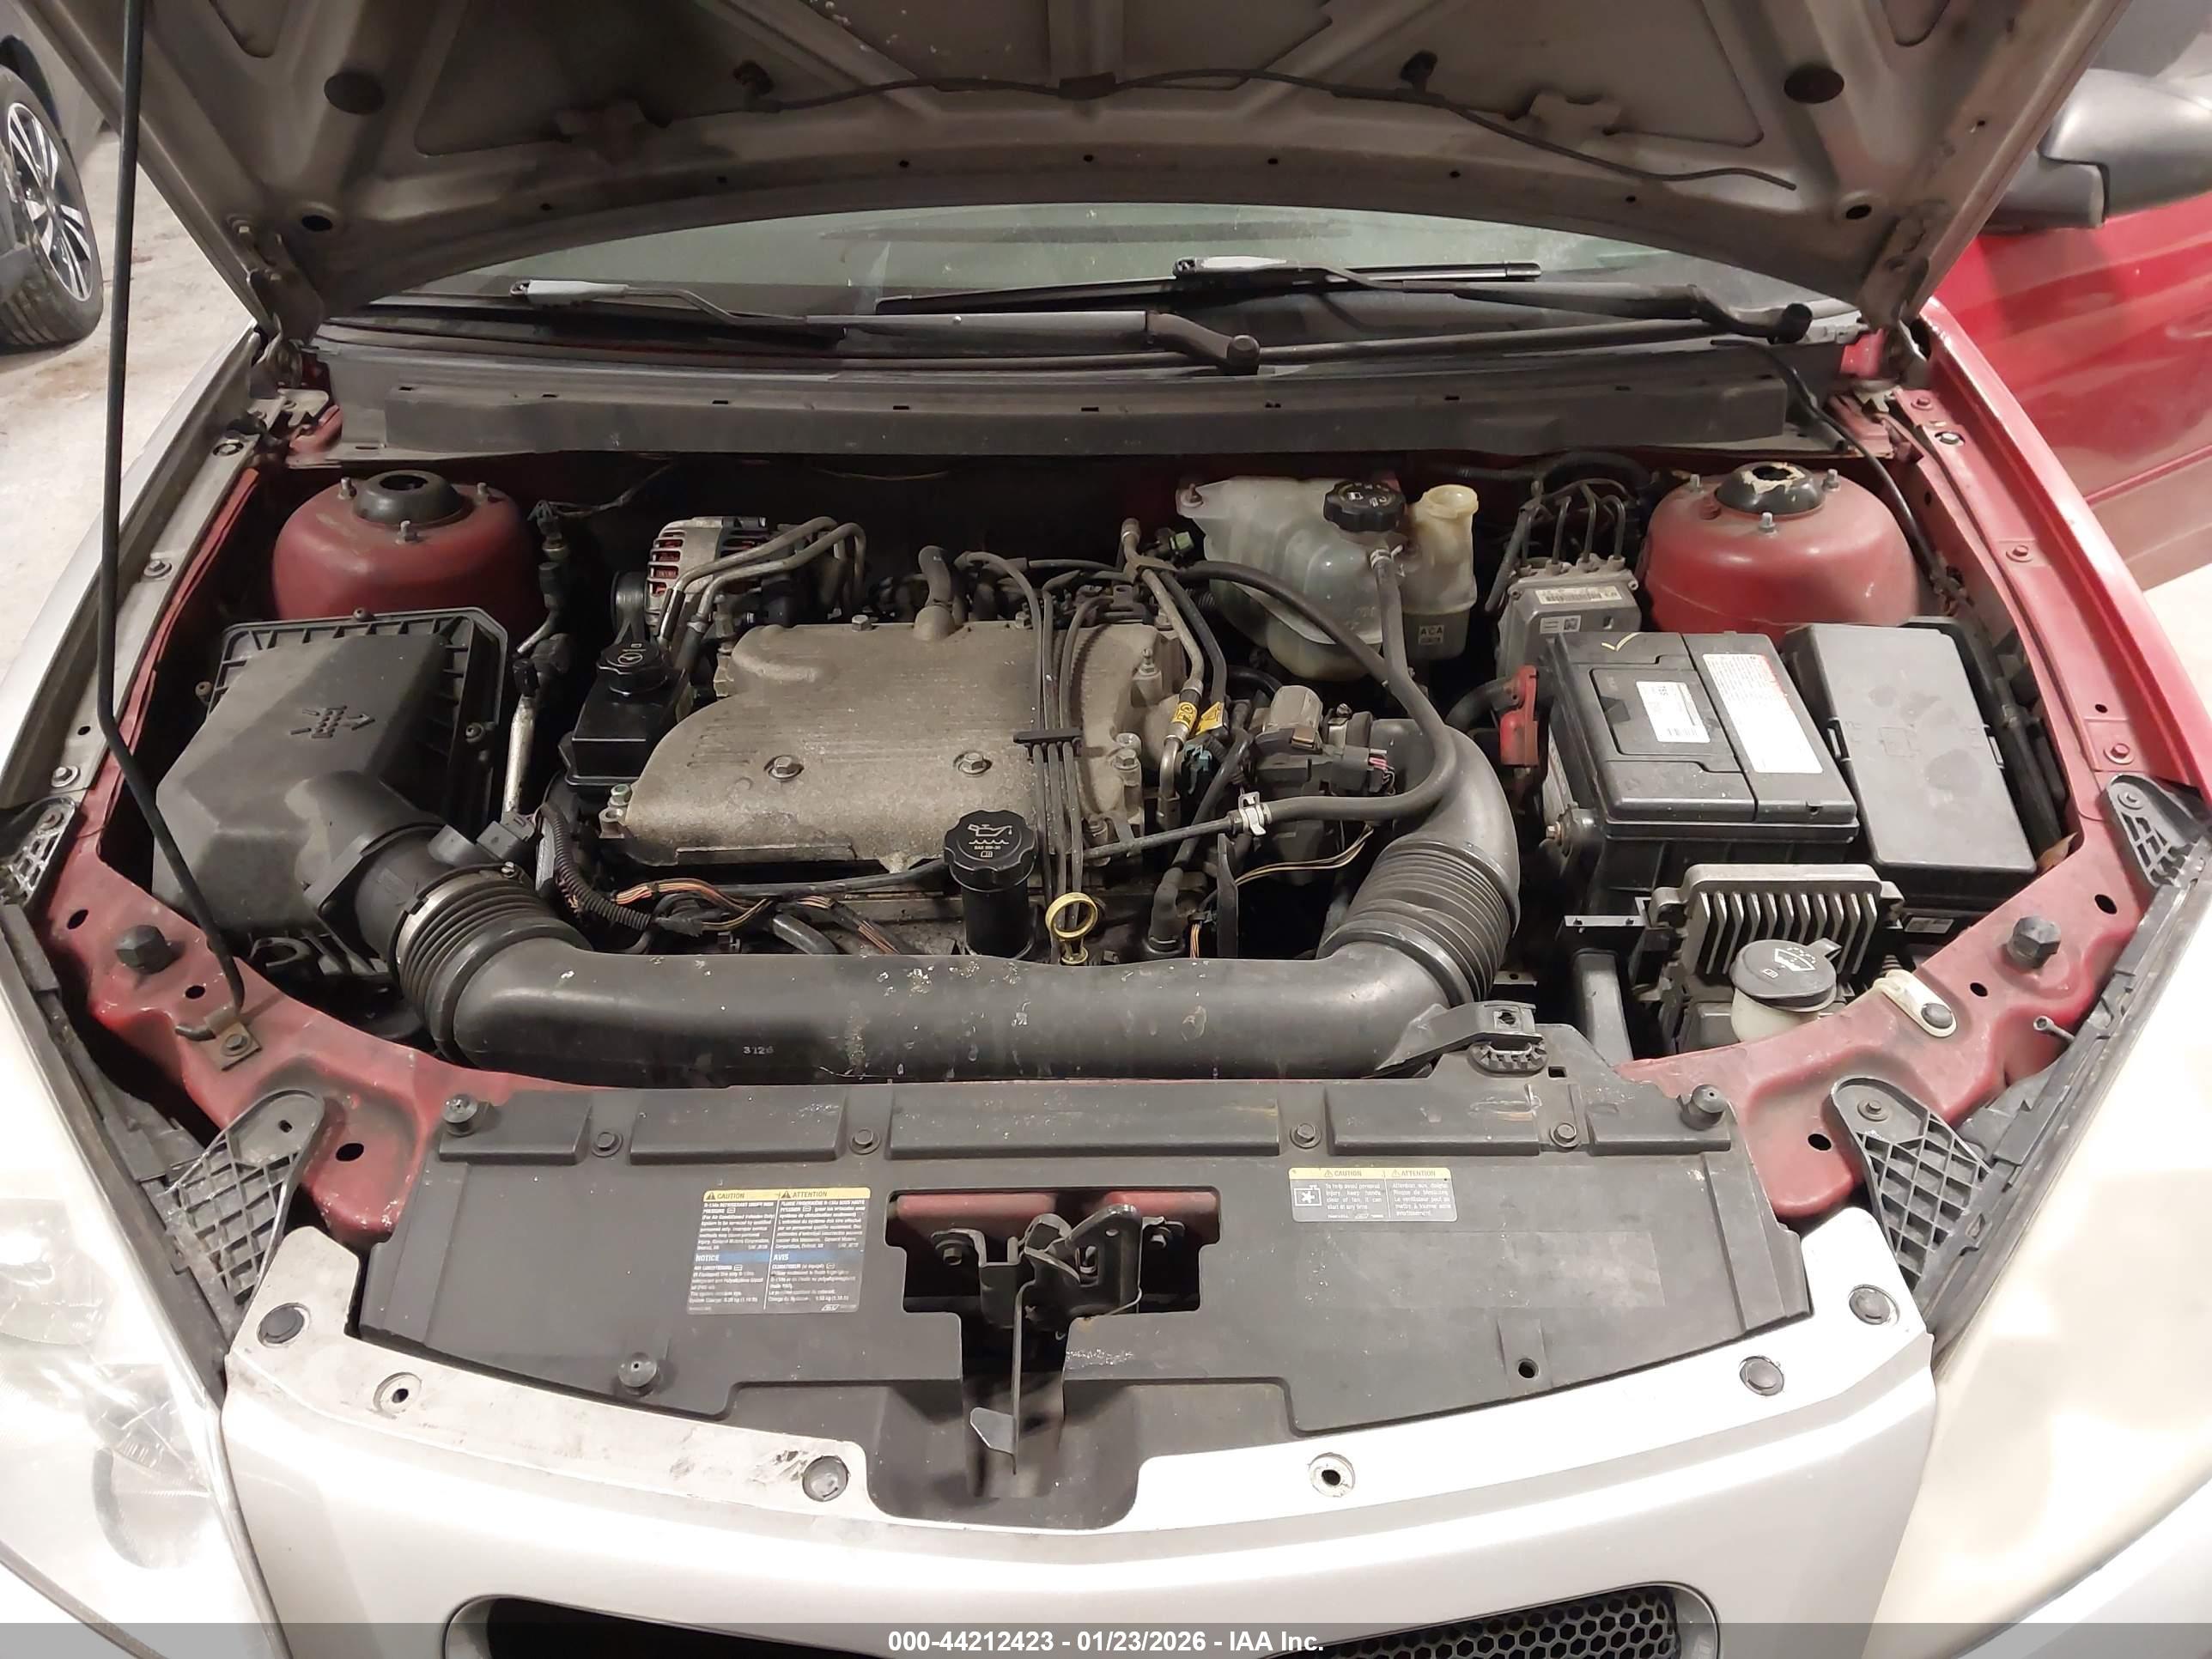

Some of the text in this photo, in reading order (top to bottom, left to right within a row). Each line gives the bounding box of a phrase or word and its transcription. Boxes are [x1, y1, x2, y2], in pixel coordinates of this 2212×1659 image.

[792, 1190, 828, 1199] ATTENTION
[695, 1254, 720, 1262] NOTICE
[773, 1253, 789, 1261] AVIS
